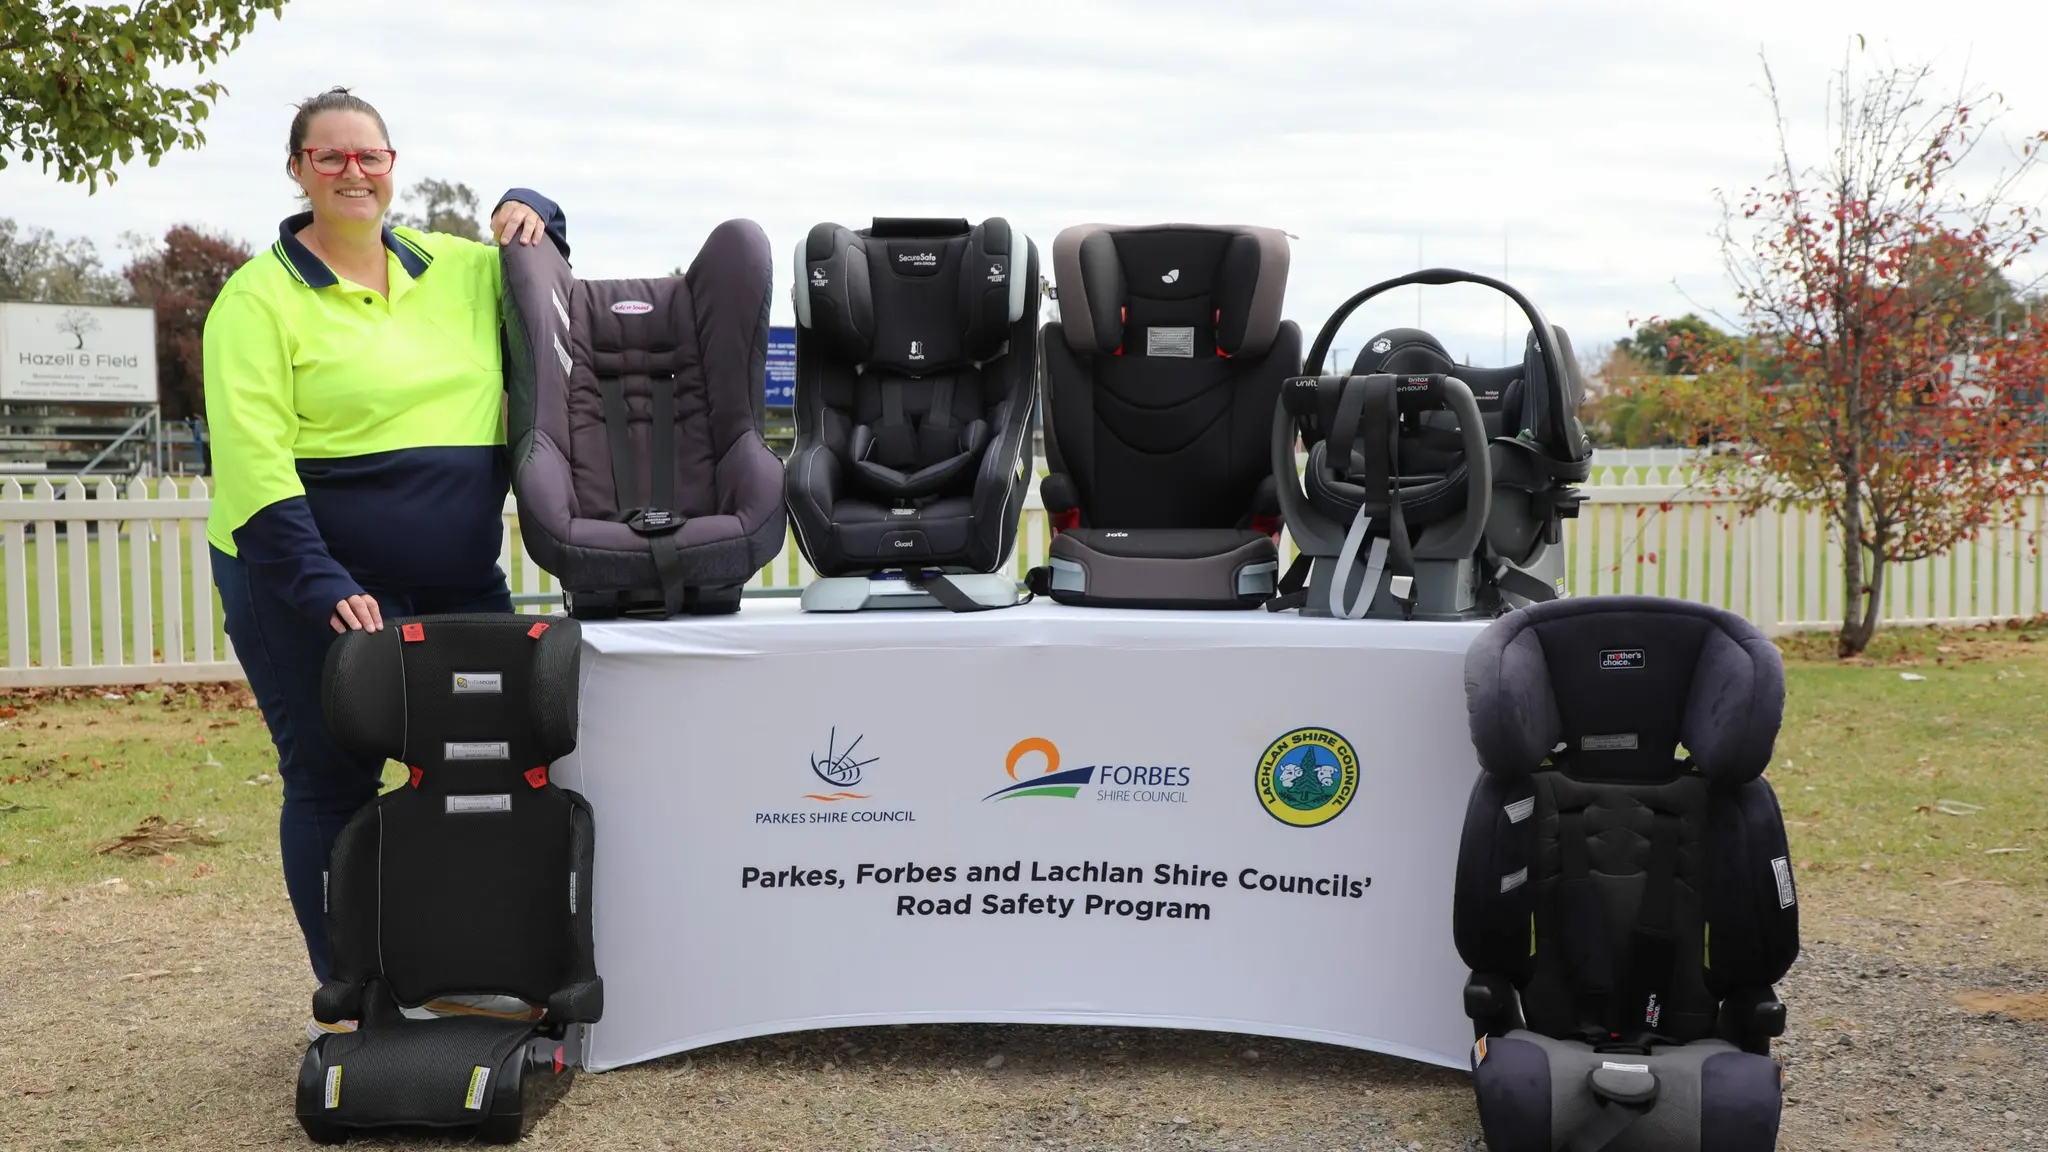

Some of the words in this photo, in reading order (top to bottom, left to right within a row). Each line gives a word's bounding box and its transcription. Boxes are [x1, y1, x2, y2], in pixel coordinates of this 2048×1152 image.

[899, 252, 937, 262] SecureSafe
[19, 351, 74, 367] Hazell
[79, 353, 91, 368] &
[96, 353, 138, 369] Field
[1100, 765, 1190, 787] FORBES
[1261, 741, 1289, 804] LACHLAN
[1291, 732, 1338, 747] SHIRE
[1331, 745, 1354, 806] COUNCIL
[1097, 789, 1130, 802] SHIRE
[1133, 790, 1188, 803] COUNCIL
[755, 812, 806, 824] PARKES
[809, 811, 848, 824] SHIRE
[851, 811, 917, 823] COUNCIL
[742, 865, 845, 889] Parkes,
[856, 862, 957, 884] Forbes
[966, 861, 1020, 882] and
[1031, 861, 1143, 883] Lachlan
[1153, 863, 1228, 888] Shire
[896, 893, 972, 916] Road
[981, 893, 1074, 918] Safety
[1085, 894, 1211, 921] Program
